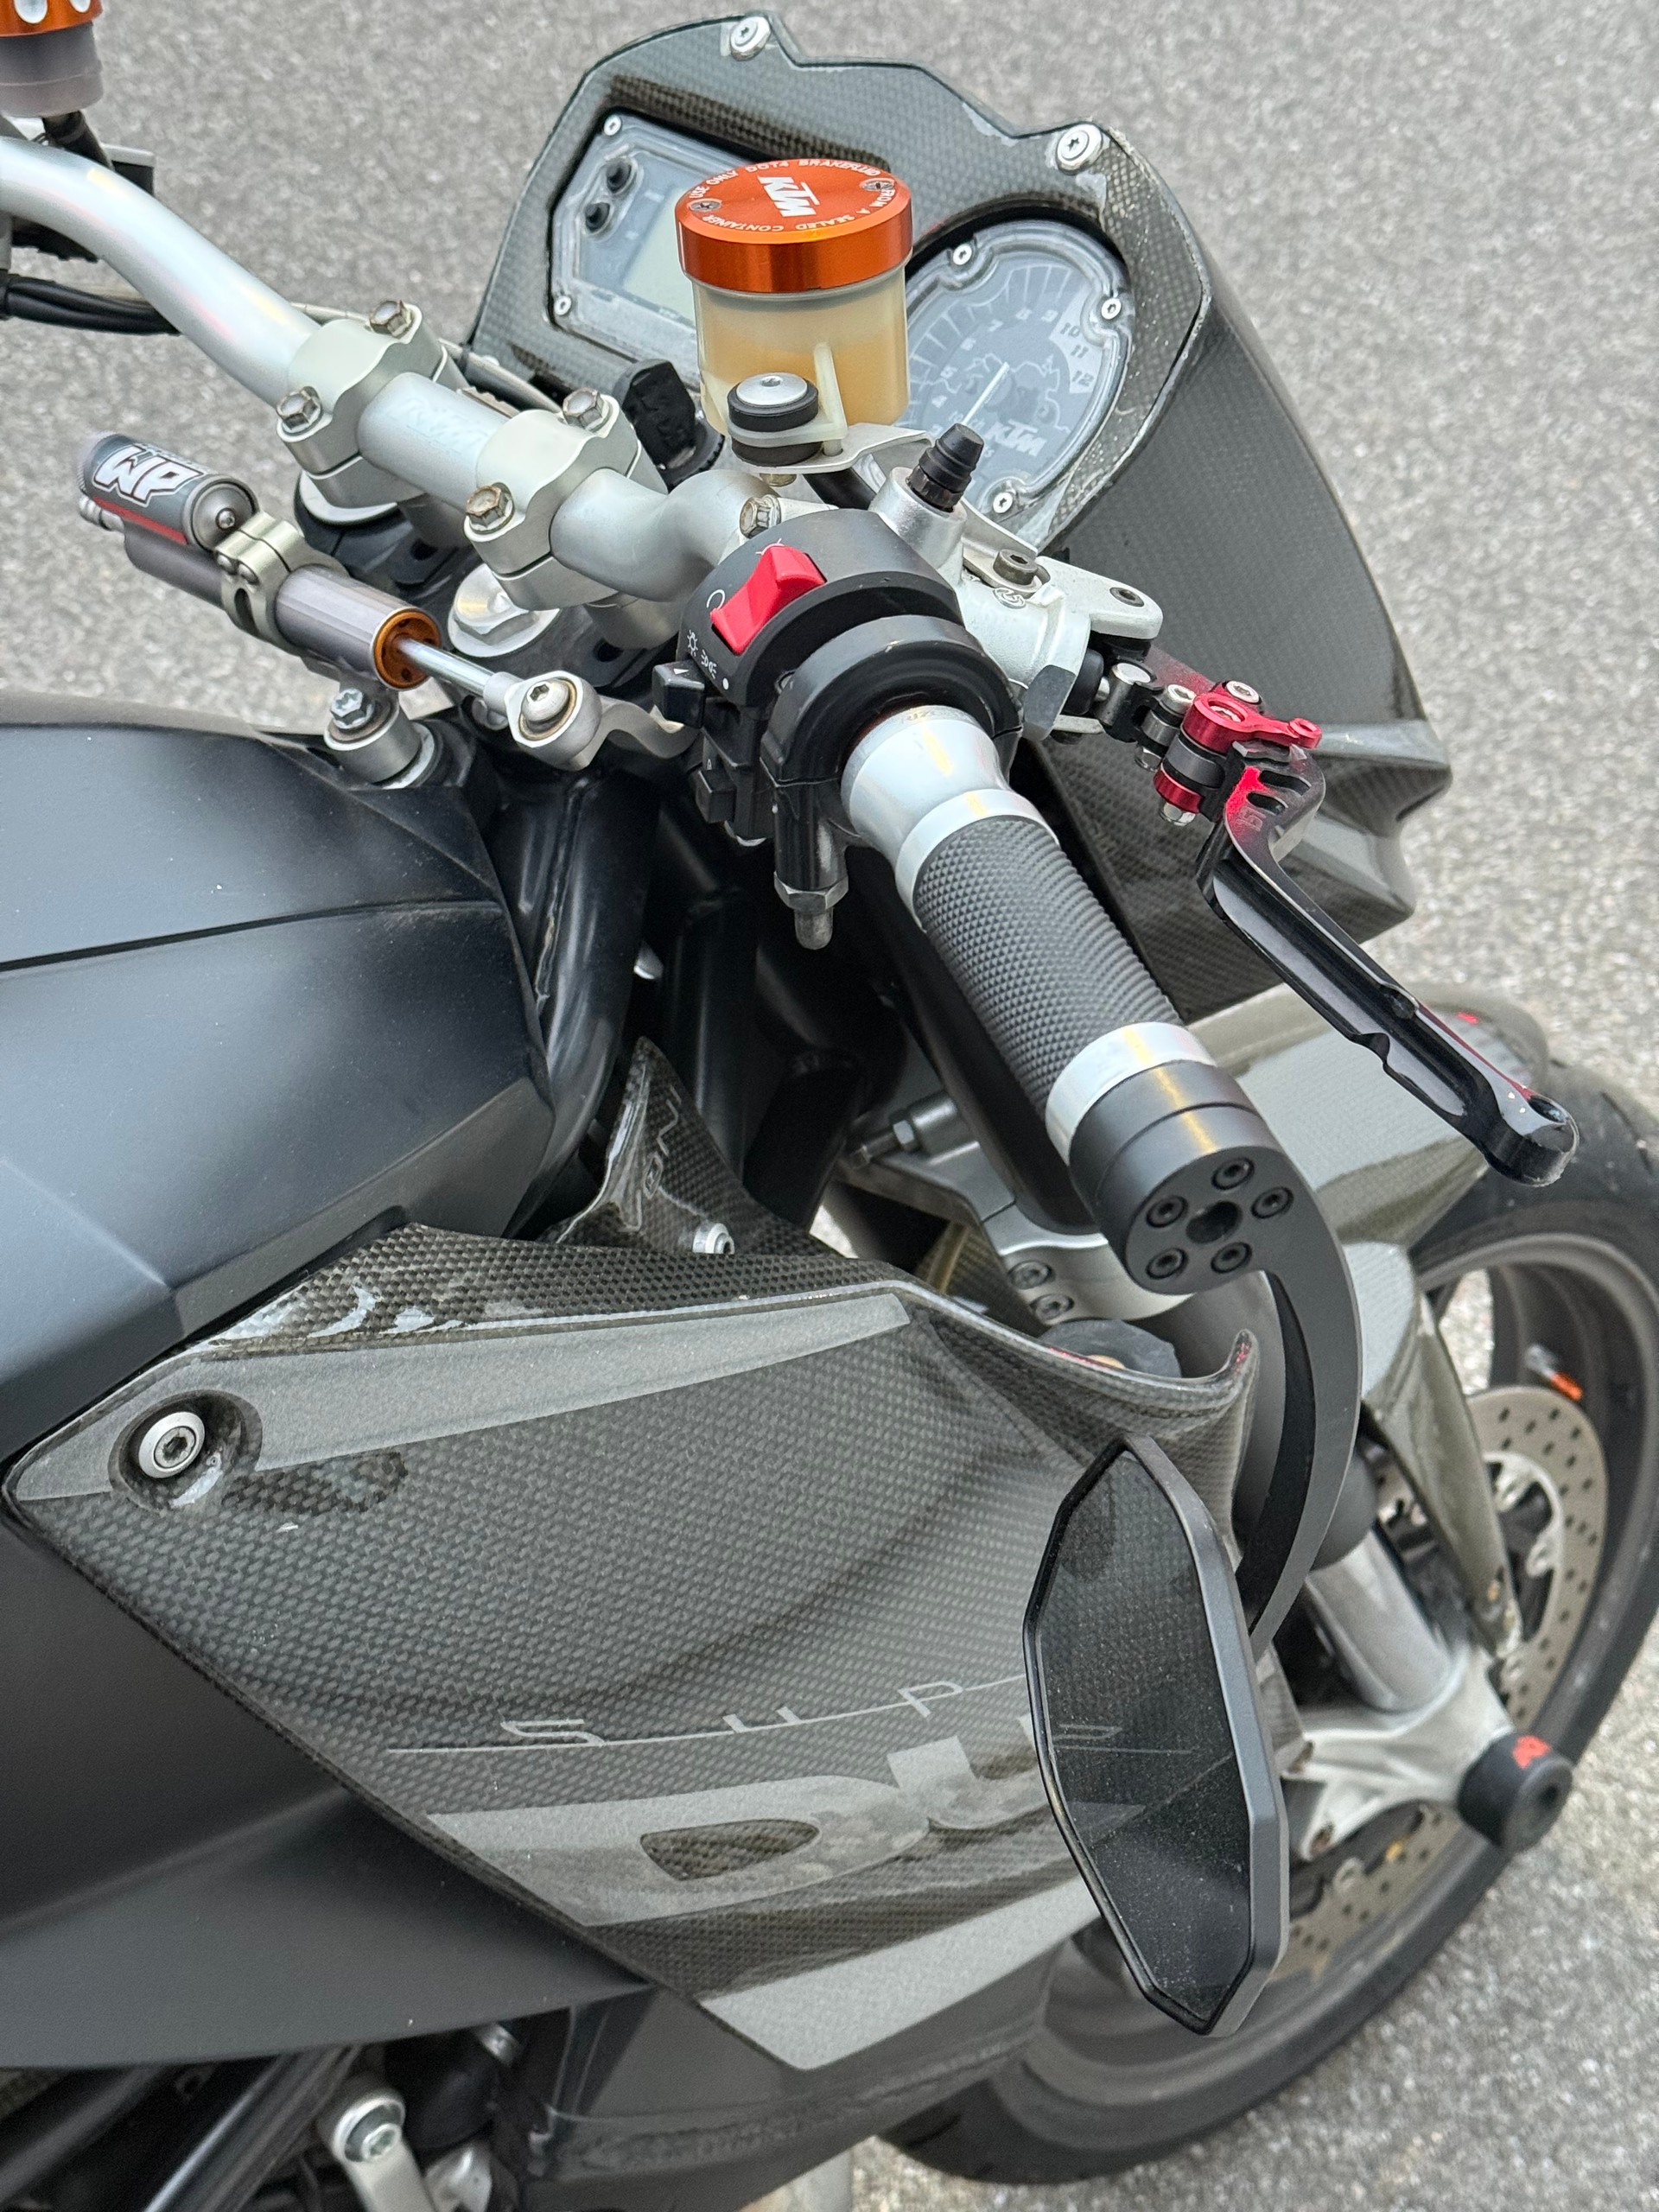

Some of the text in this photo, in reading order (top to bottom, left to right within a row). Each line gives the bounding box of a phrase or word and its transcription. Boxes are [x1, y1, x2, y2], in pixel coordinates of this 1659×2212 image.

[745, 159, 789, 173] DOT4
[706, 169, 739, 186] ONLY
[689, 185, 710, 199] USE
[757, 175, 821, 218] KTM
[702, 214, 785, 232] CONTAINER
[795, 214, 855, 231] SEALED
[1070, 344, 1090, 359] 11
[1071, 370, 1096, 388] 12
[985, 418, 1048, 458] KTM
[92, 443, 207, 508] WP
